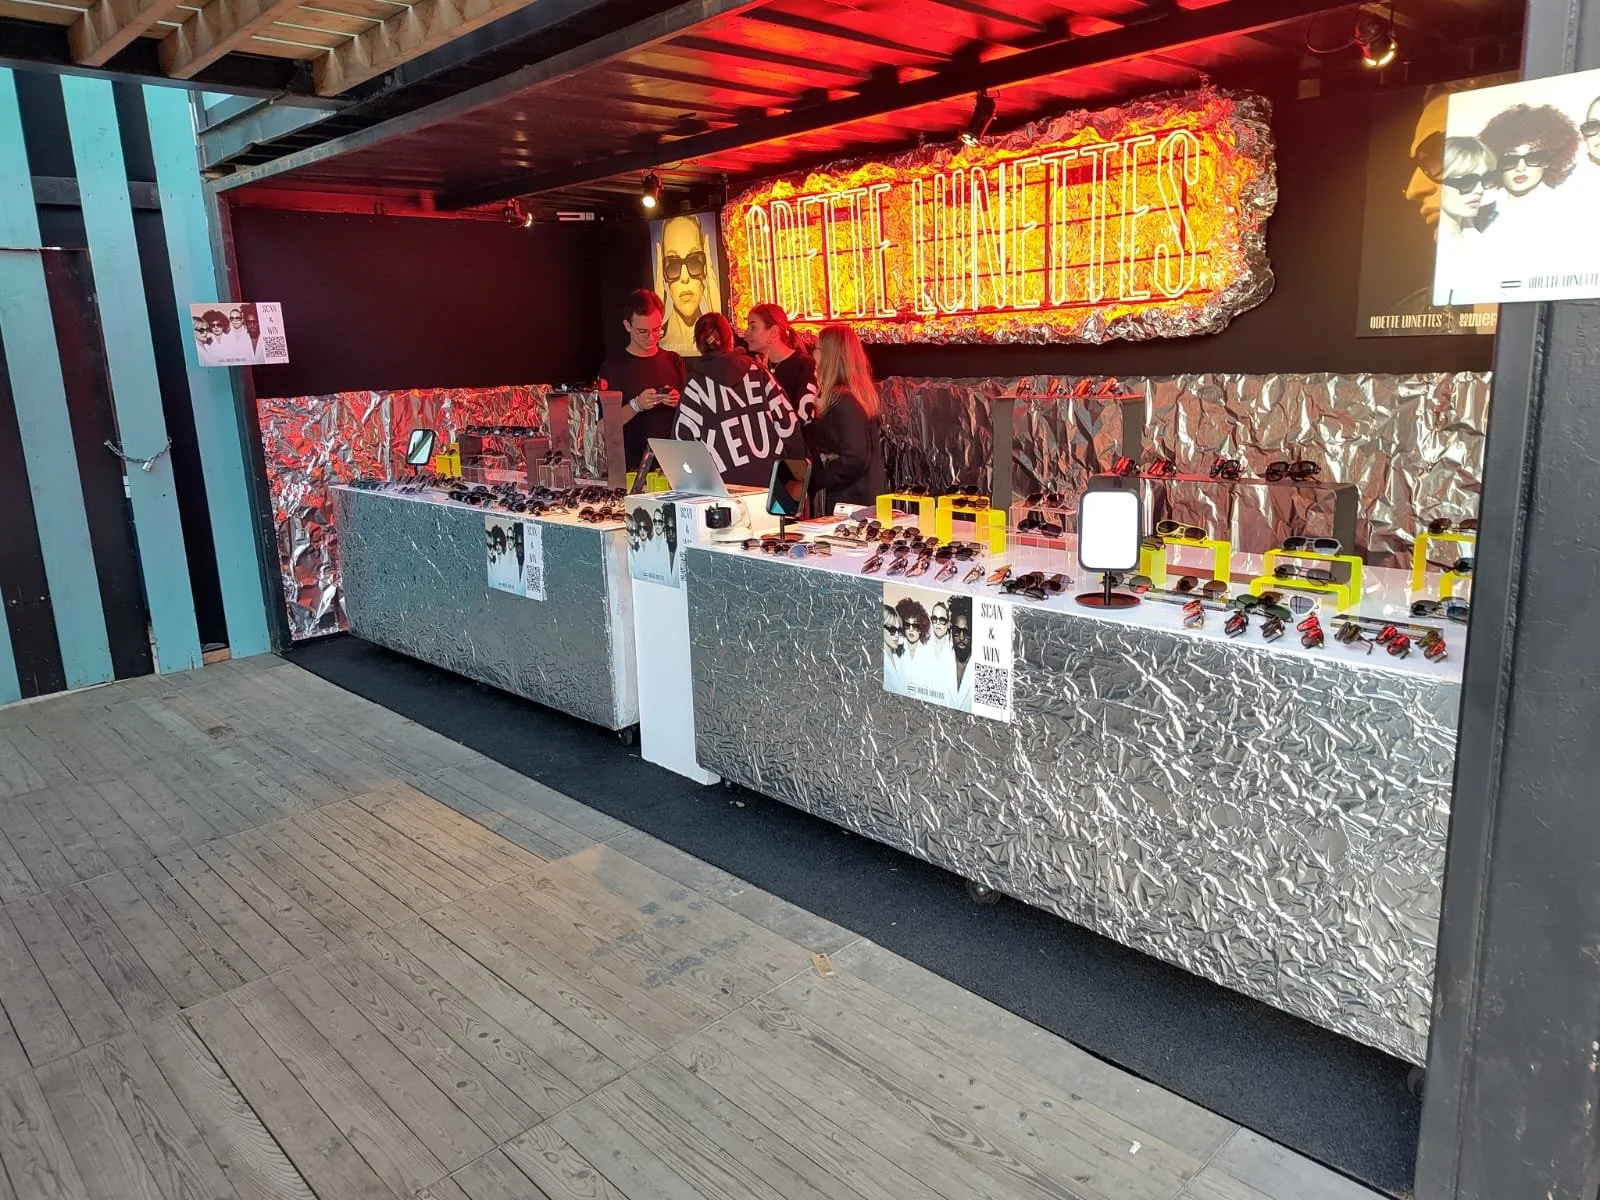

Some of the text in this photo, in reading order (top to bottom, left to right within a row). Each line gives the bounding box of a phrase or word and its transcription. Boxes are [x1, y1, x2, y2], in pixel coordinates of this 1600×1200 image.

[745, 129, 1200, 321] ODETTE LUNETTES
[261, 304, 278, 313] SCAN
[1370, 315, 1400, 329] ODETTE
[1401, 313, 1443, 328] LUNETTES
[266, 326, 279, 336] WIN
[981, 602, 1004, 621] SCAN
[988, 627, 996, 640] &
[982, 645, 1001, 664] WIN
